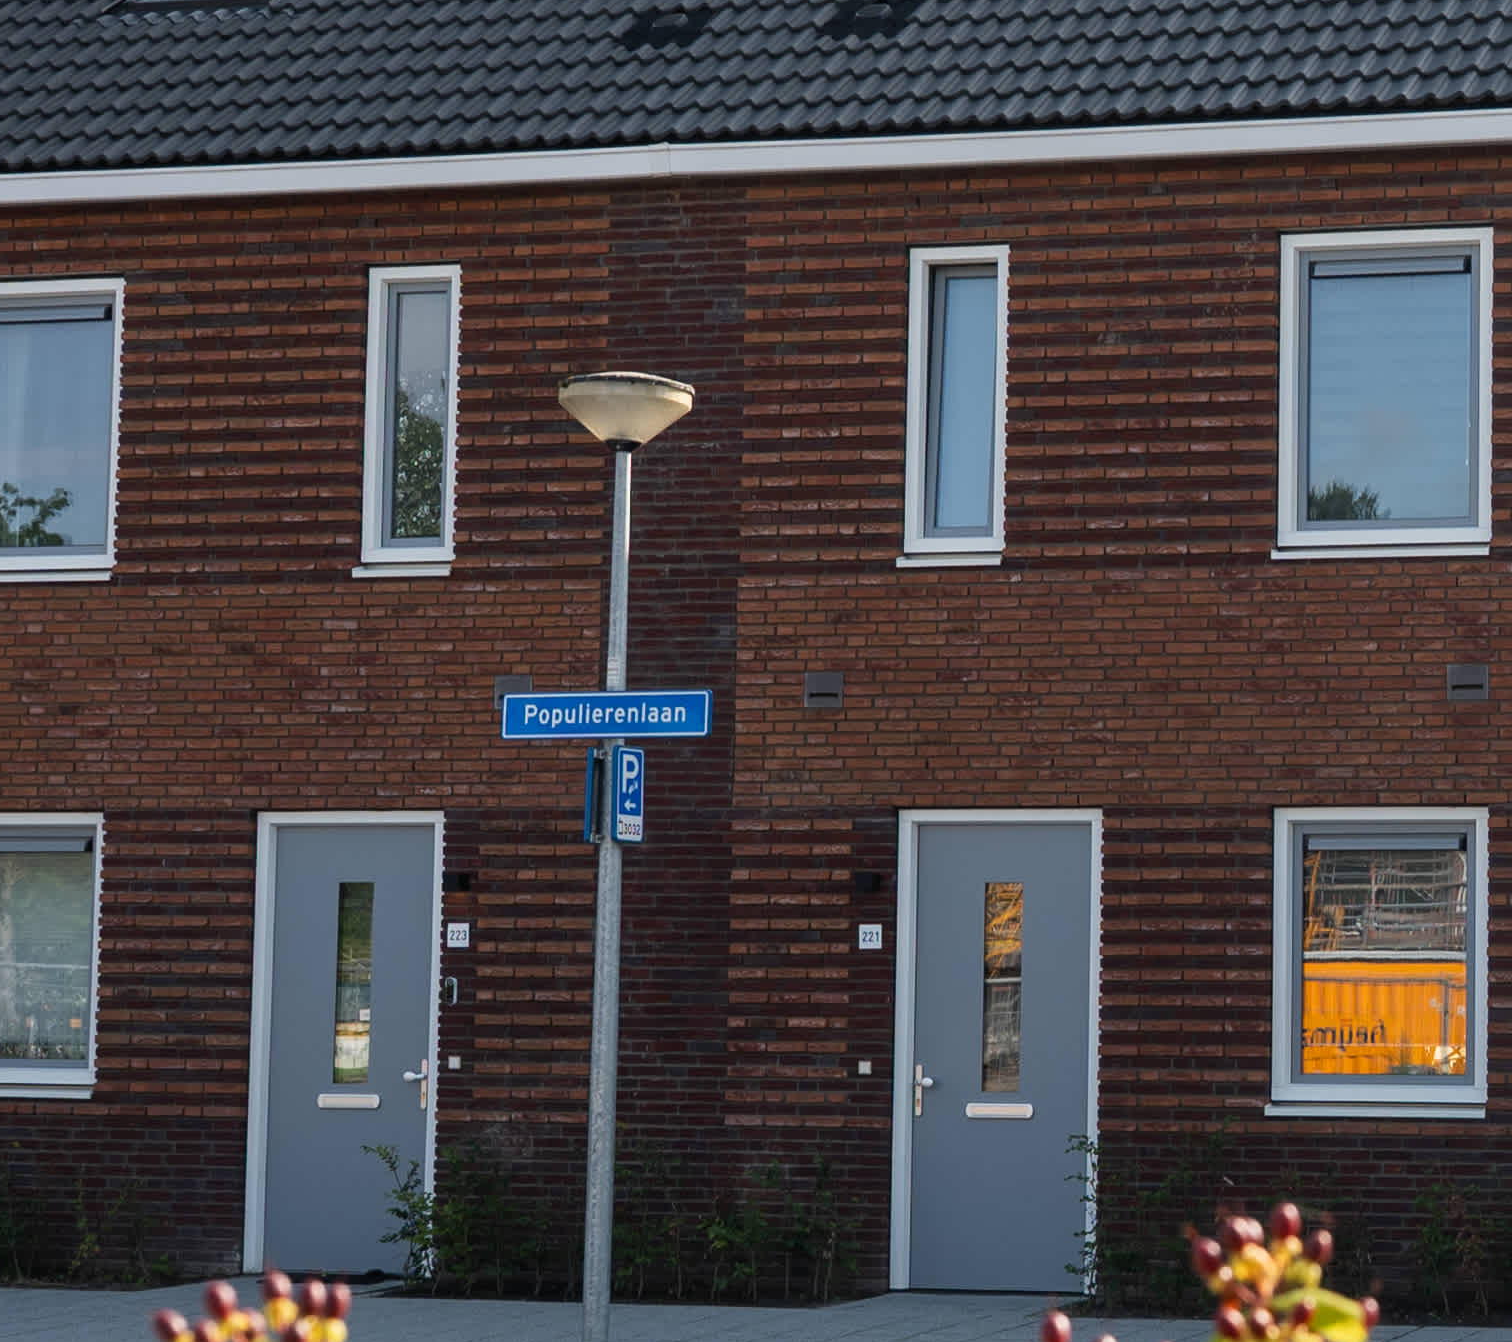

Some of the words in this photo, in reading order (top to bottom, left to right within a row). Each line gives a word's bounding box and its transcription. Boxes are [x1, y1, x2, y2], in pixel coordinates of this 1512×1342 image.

[524, 703, 687, 728] Populierenlaan
[624, 823, 641, 836] 3032
[449, 930, 468, 941] 223
[862, 930, 880, 943] 221
